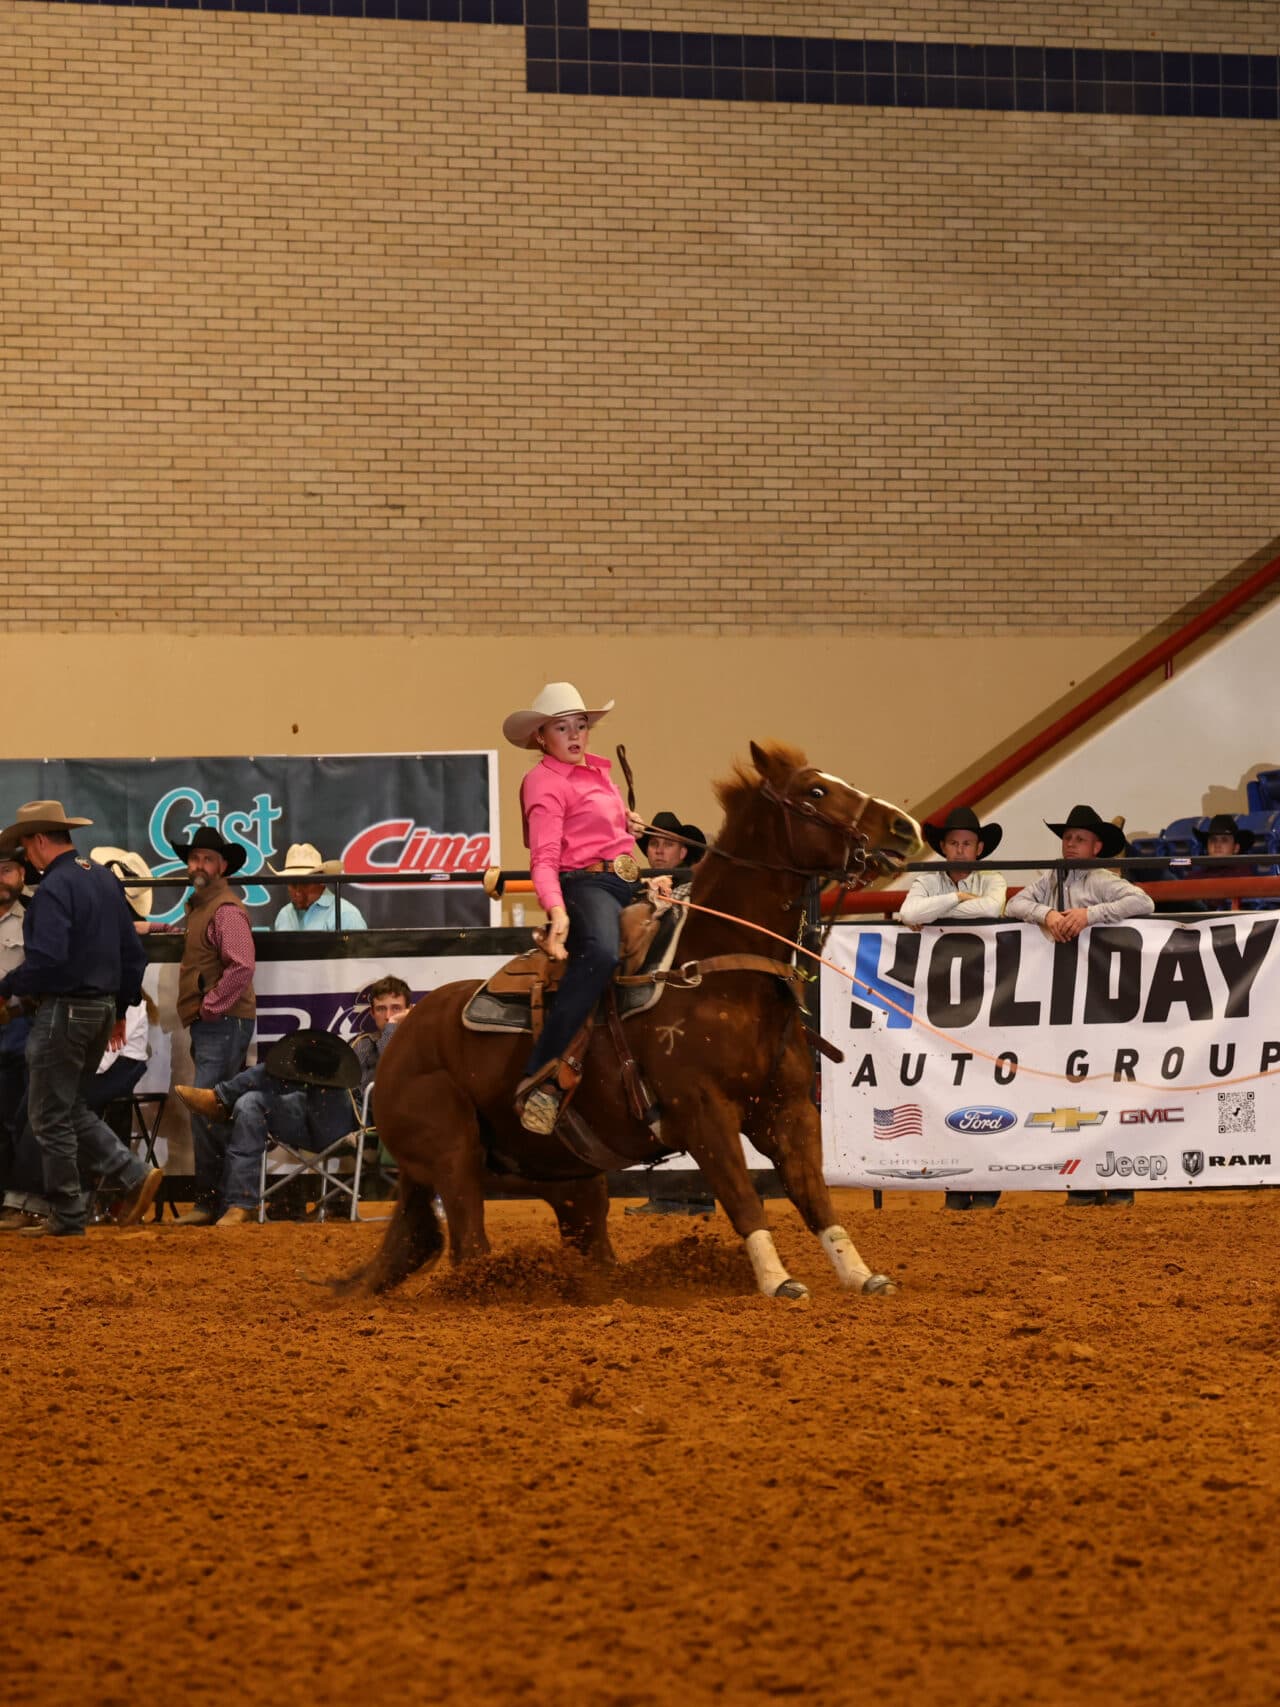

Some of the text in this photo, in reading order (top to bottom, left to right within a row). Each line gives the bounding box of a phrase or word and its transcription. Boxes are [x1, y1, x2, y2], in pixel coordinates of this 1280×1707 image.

[341, 819, 492, 874] Cima
[850, 919, 1279, 1029] HOLIDAY
[852, 1051, 1020, 1087] AUTO
[958, 1109, 1003, 1130] Ford
[1119, 1107, 1184, 1124] GMC
[988, 1163, 1064, 1172] DODGE
[1095, 1150, 1168, 1180] Jeep
[1208, 1154, 1272, 1167] RAM
